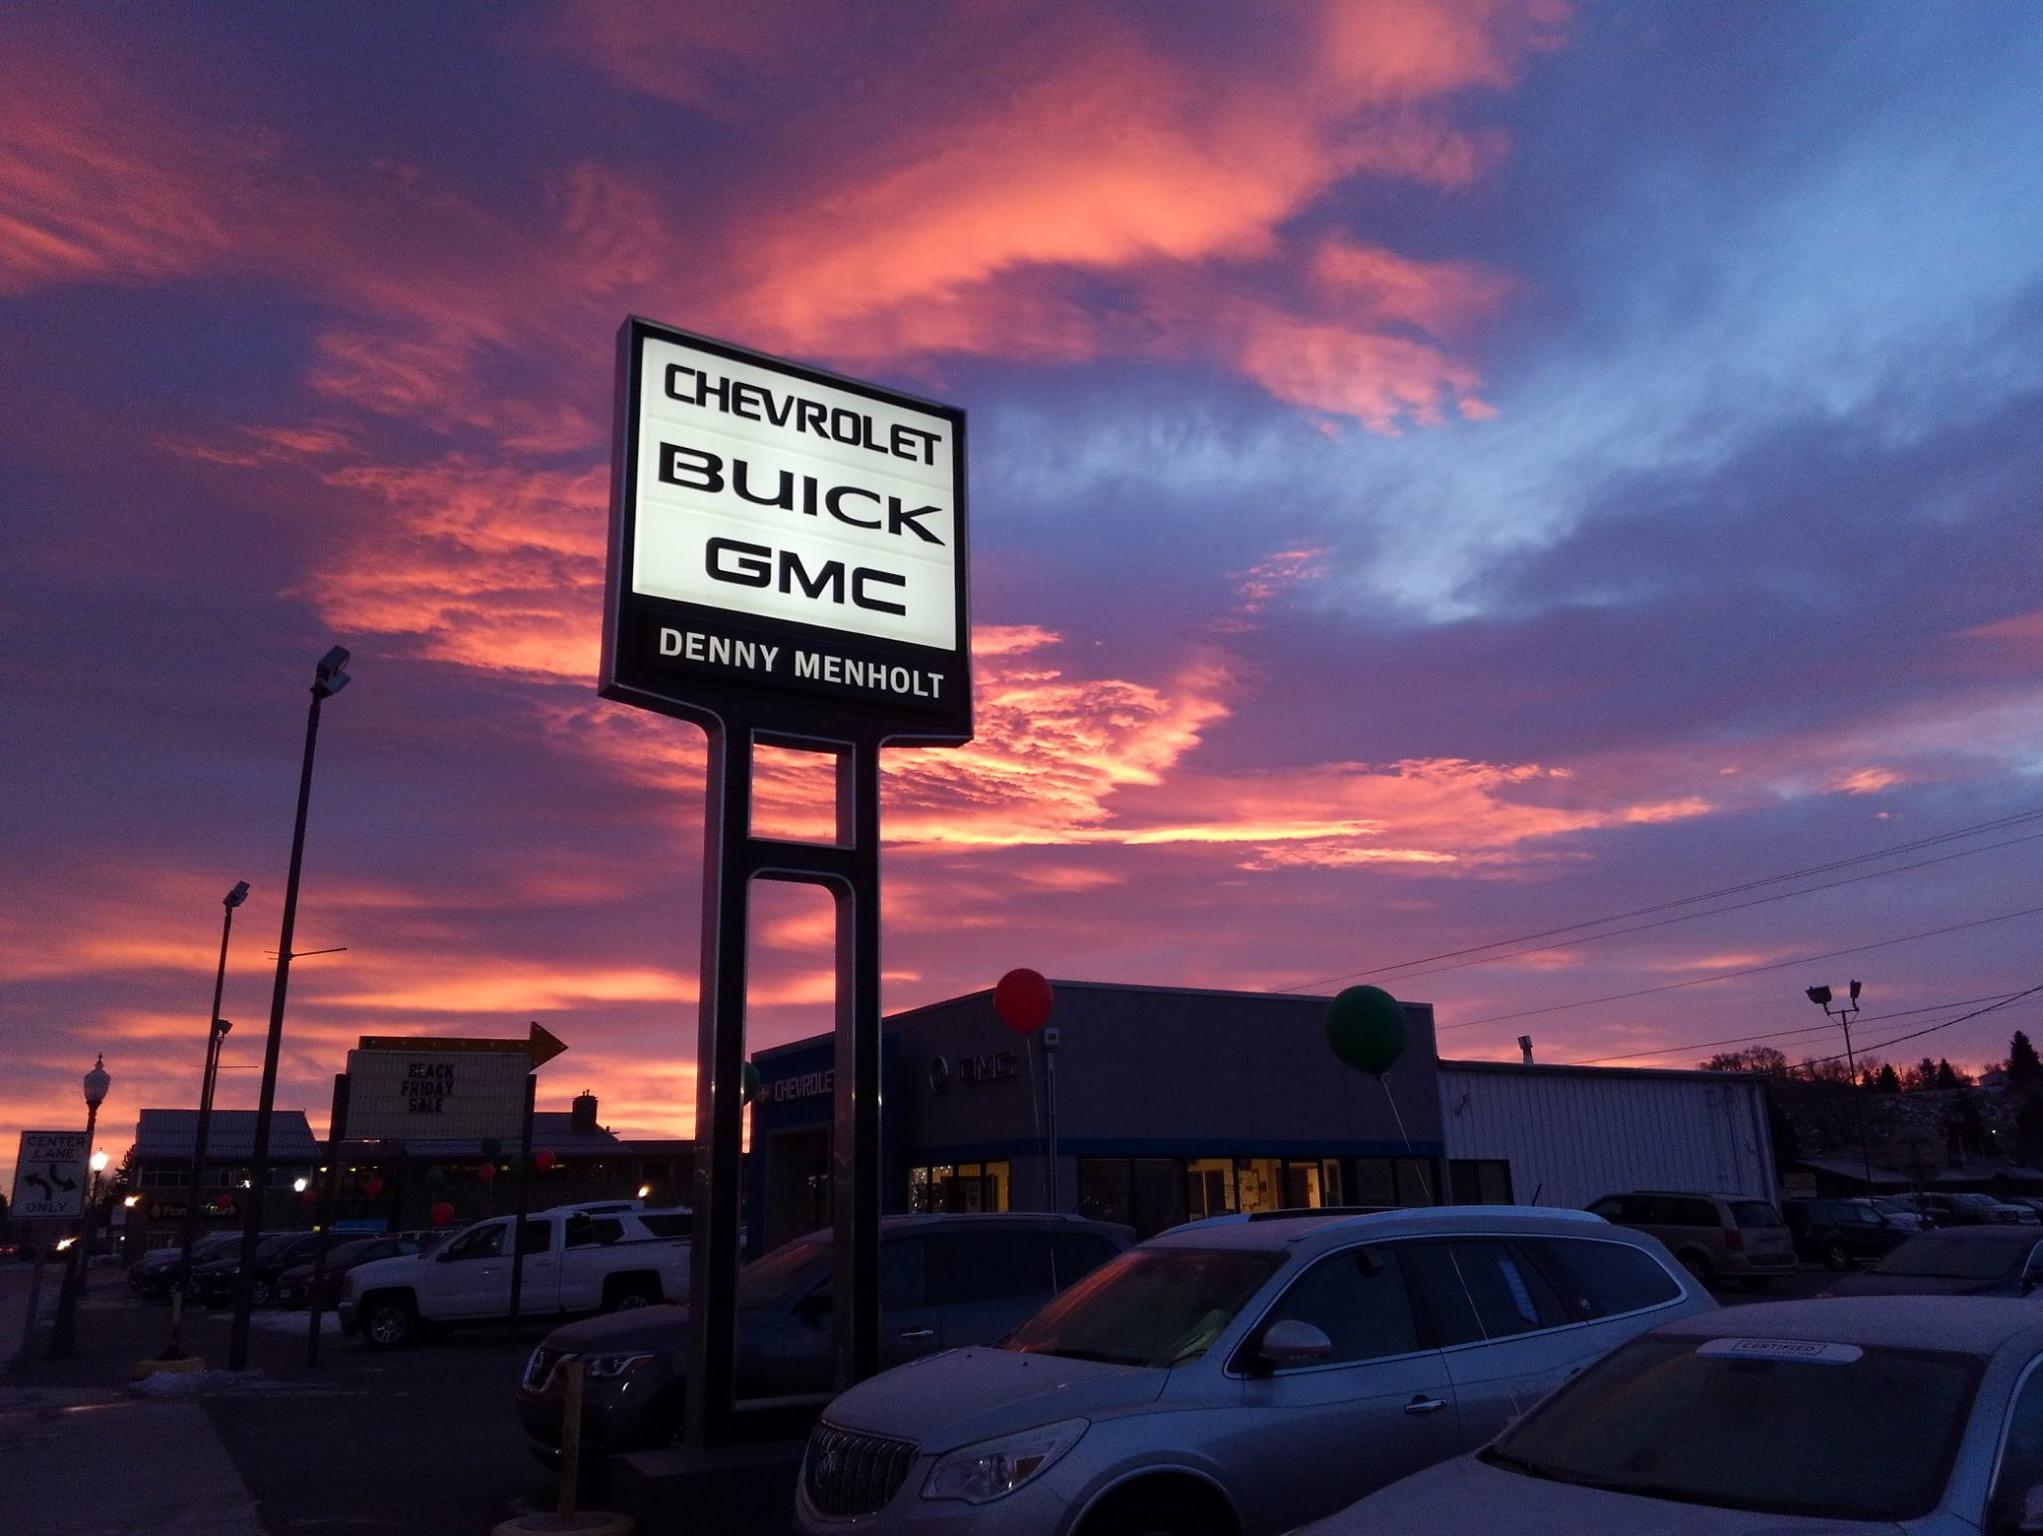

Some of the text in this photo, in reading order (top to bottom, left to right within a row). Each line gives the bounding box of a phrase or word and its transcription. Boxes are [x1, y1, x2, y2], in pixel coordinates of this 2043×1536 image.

[665, 362, 942, 466] CHEVROLET
[658, 441, 946, 546] BUICK
[705, 536, 906, 616] GMC
[659, 627, 944, 698] DENNY MENHOLT
[408, 1064, 454, 1079] BLACK
[401, 1081, 454, 1096] FRIDAY
[774, 1068, 836, 1102] CHEVROLE
[408, 1098, 442, 1113] SALE
[28, 1136, 85, 1147] CENTER
[34, 1148, 74, 1158] LANE
[26, 1202, 67, 1213] ONLY
